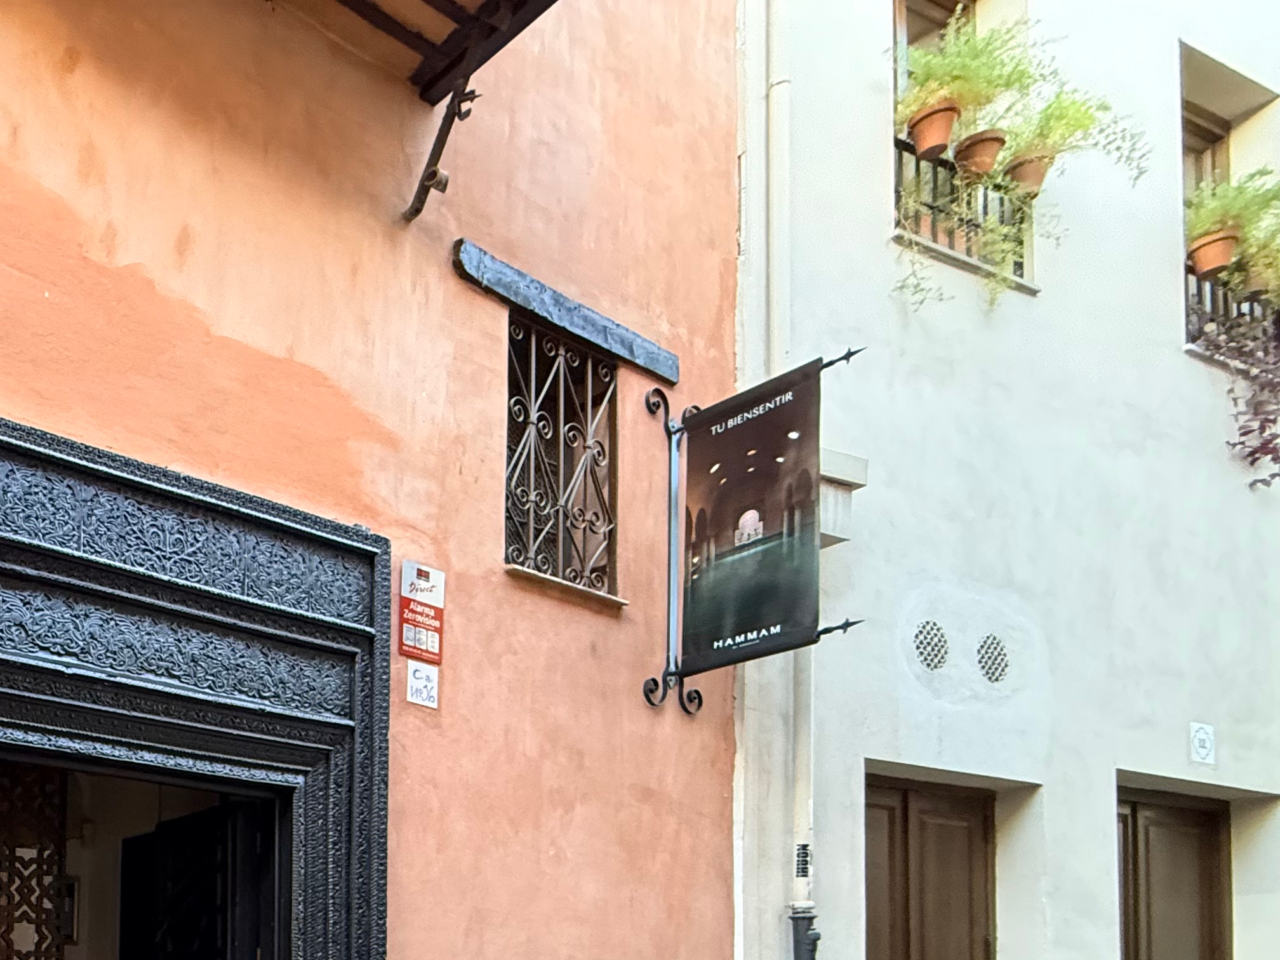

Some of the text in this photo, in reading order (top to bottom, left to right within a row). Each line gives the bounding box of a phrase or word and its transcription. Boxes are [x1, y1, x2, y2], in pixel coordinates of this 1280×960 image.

[709, 391, 793, 435] TU BIENSENTIR
[409, 581, 437, 593] Direct
[409, 601, 435, 617] Alarma
[713, 624, 781, 649] HAMMAM
